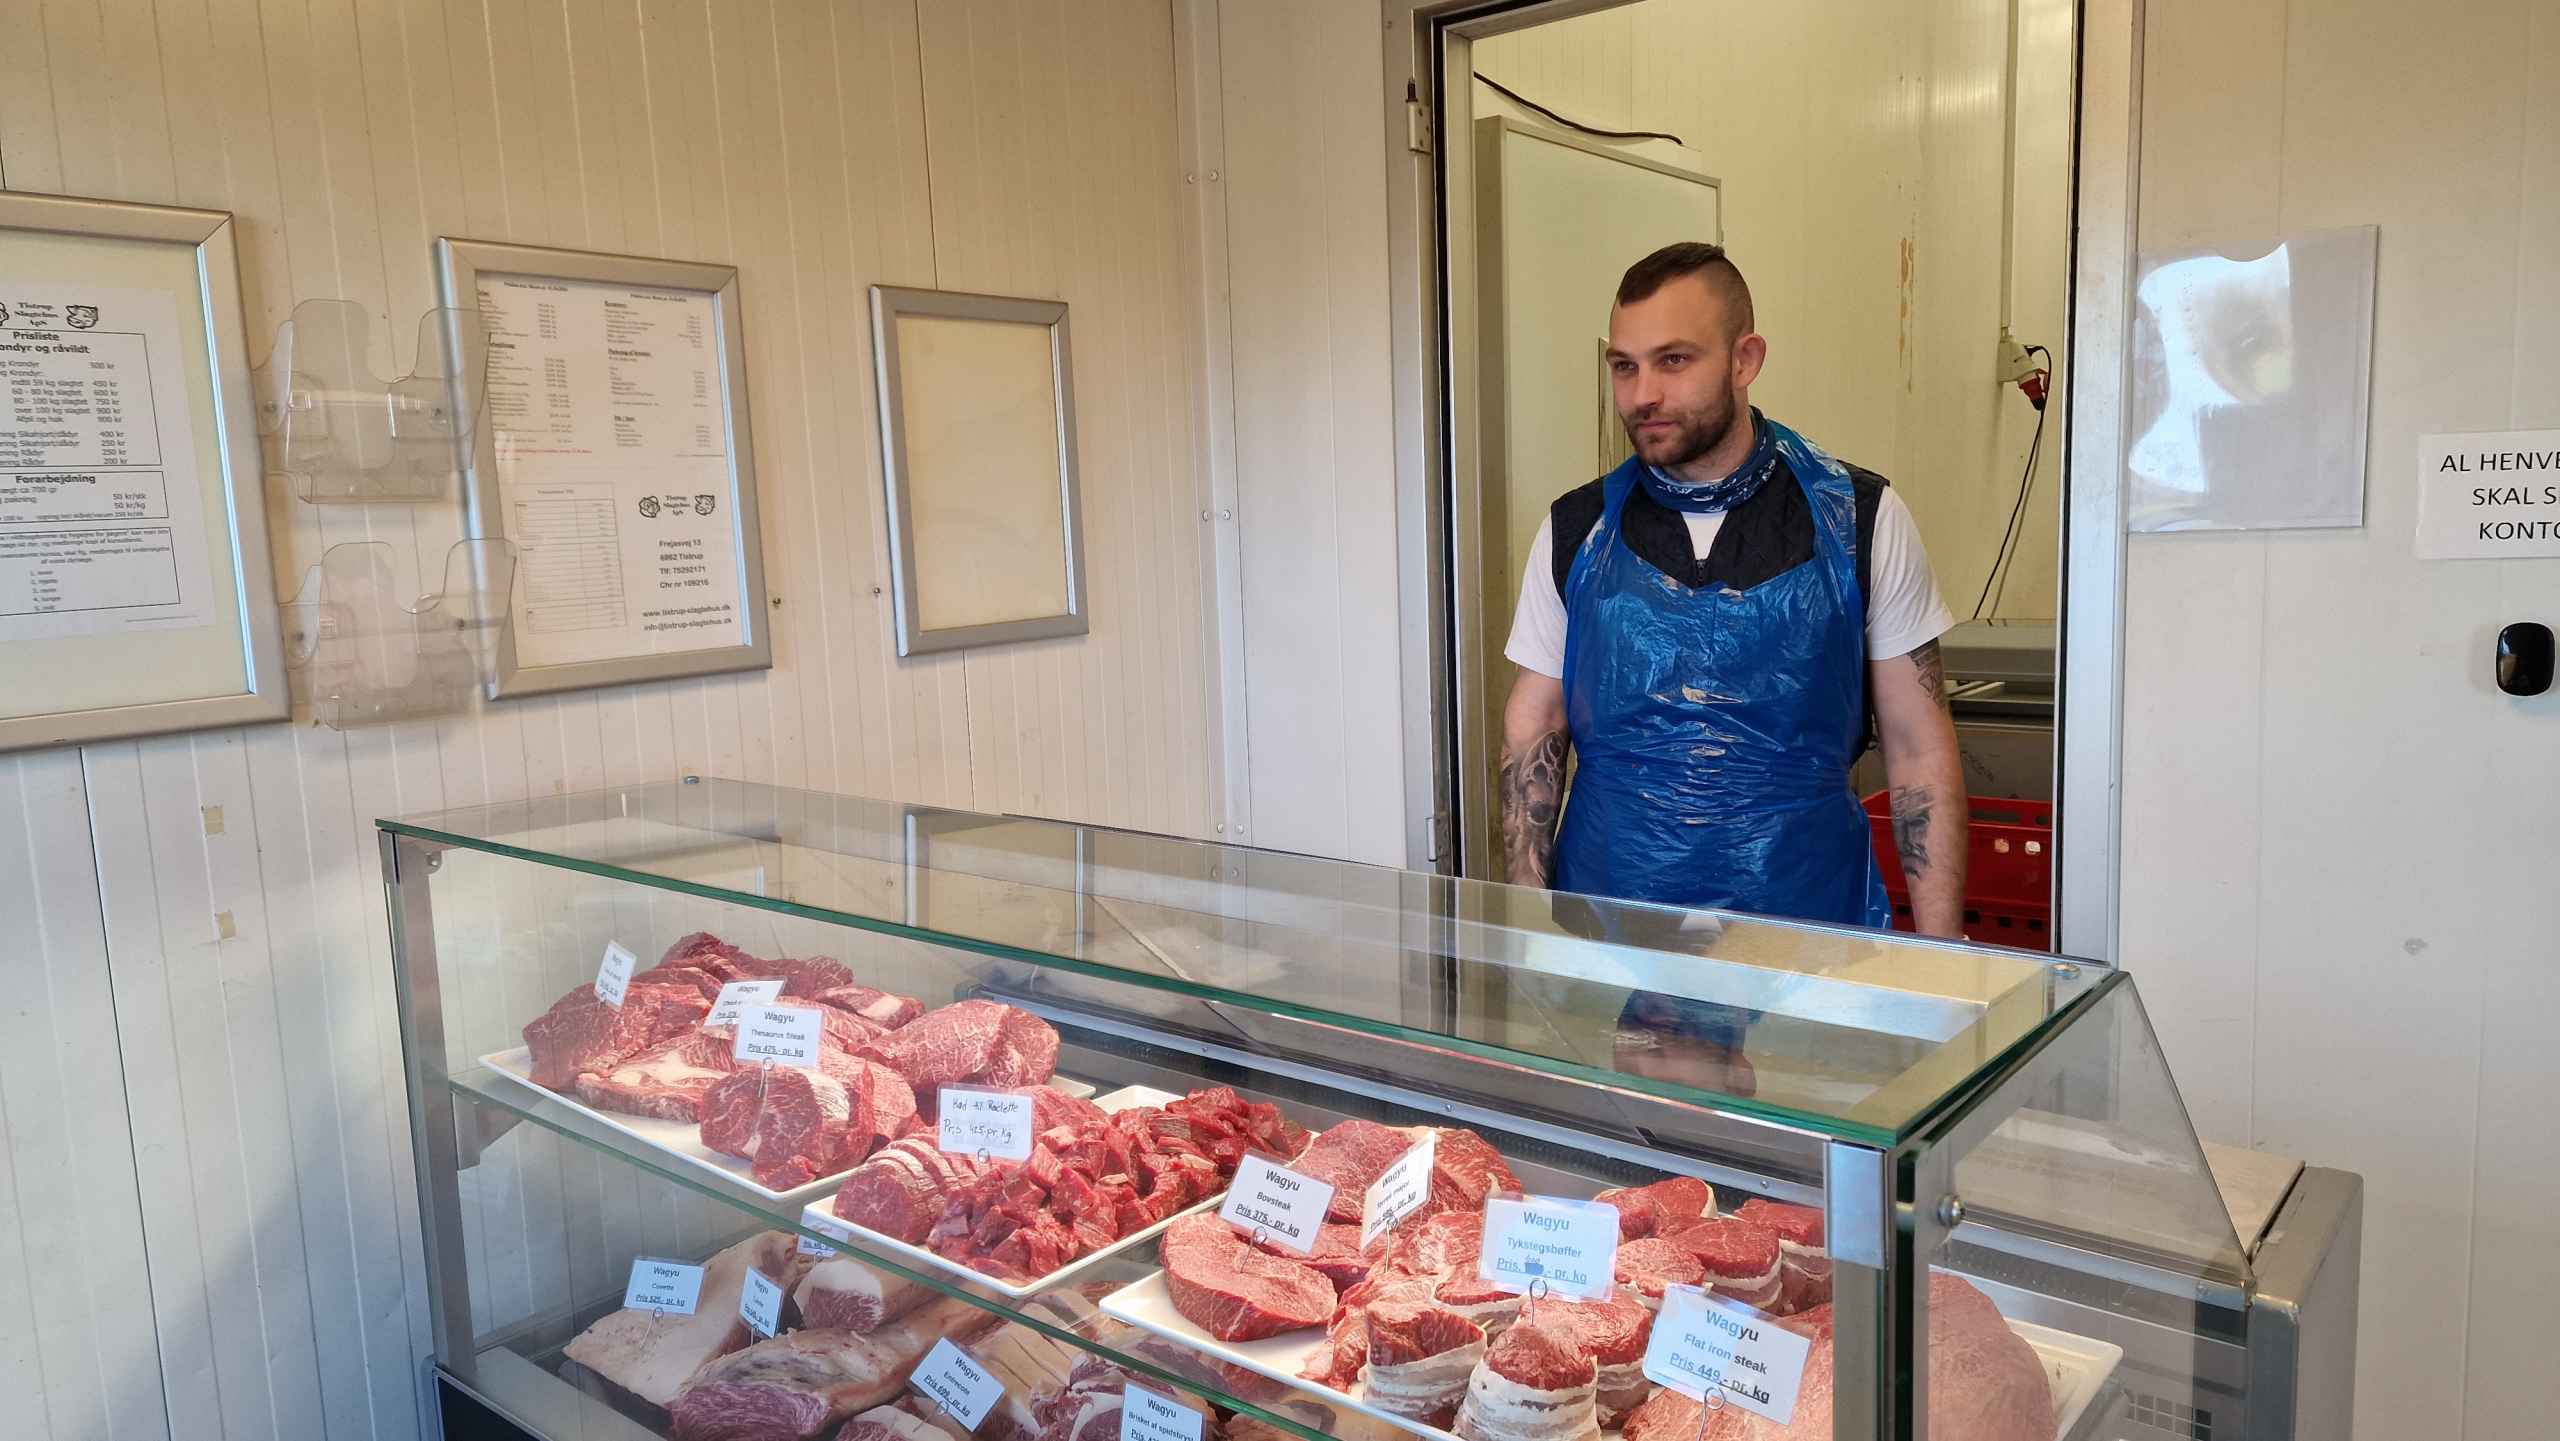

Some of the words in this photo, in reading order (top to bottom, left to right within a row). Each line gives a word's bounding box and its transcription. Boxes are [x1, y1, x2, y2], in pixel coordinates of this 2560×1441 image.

[13, 331, 60, 341] Prisliste
[35, 345, 50, 354] og
[53, 343, 91, 353] råvildt
[2440, 454, 2471, 472] AL
[15, 474, 96, 485] Forarbejdning
[126, 501, 146, 511] kr/kg
[2472, 487, 2535, 506] SKAL
[764, 1011, 795, 1024] Wagyu
[748, 1043, 761, 1053] Pris
[1265, 1169, 1301, 1191] Wagyu
[1382, 1163, 1407, 1188] Wagyu
[1256, 1191, 1291, 1211] Bovsteak
[1235, 1203, 1251, 1218] Pris
[1274, 1219, 1287, 1232] pr.
[1287, 1223, 1300, 1238] kg
[1523, 1210, 1570, 1231] Wagyu
[1507, 1237, 1582, 1258] Tykstegsbøffer
[654, 1265, 680, 1277] Wagyu
[1554, 1268, 1569, 1281] pr.
[1573, 1269, 1587, 1284] kg
[1706, 1310, 1759, 1342] Wagyu
[1683, 1332, 1706, 1351] Flat
[1707, 1343, 1731, 1361] iron
[1734, 1354, 1768, 1375] steak
[955, 1357, 981, 1383] Wagyu
[1669, 1352, 1695, 1372] Pris
[1697, 1363, 1729, 1386] 449,-
[1731, 1378, 1749, 1396] pr.
[1752, 1384, 1770, 1404] kg
[923, 1374, 937, 1391] Pris
[1147, 1398, 1177, 1418] Wagyu
